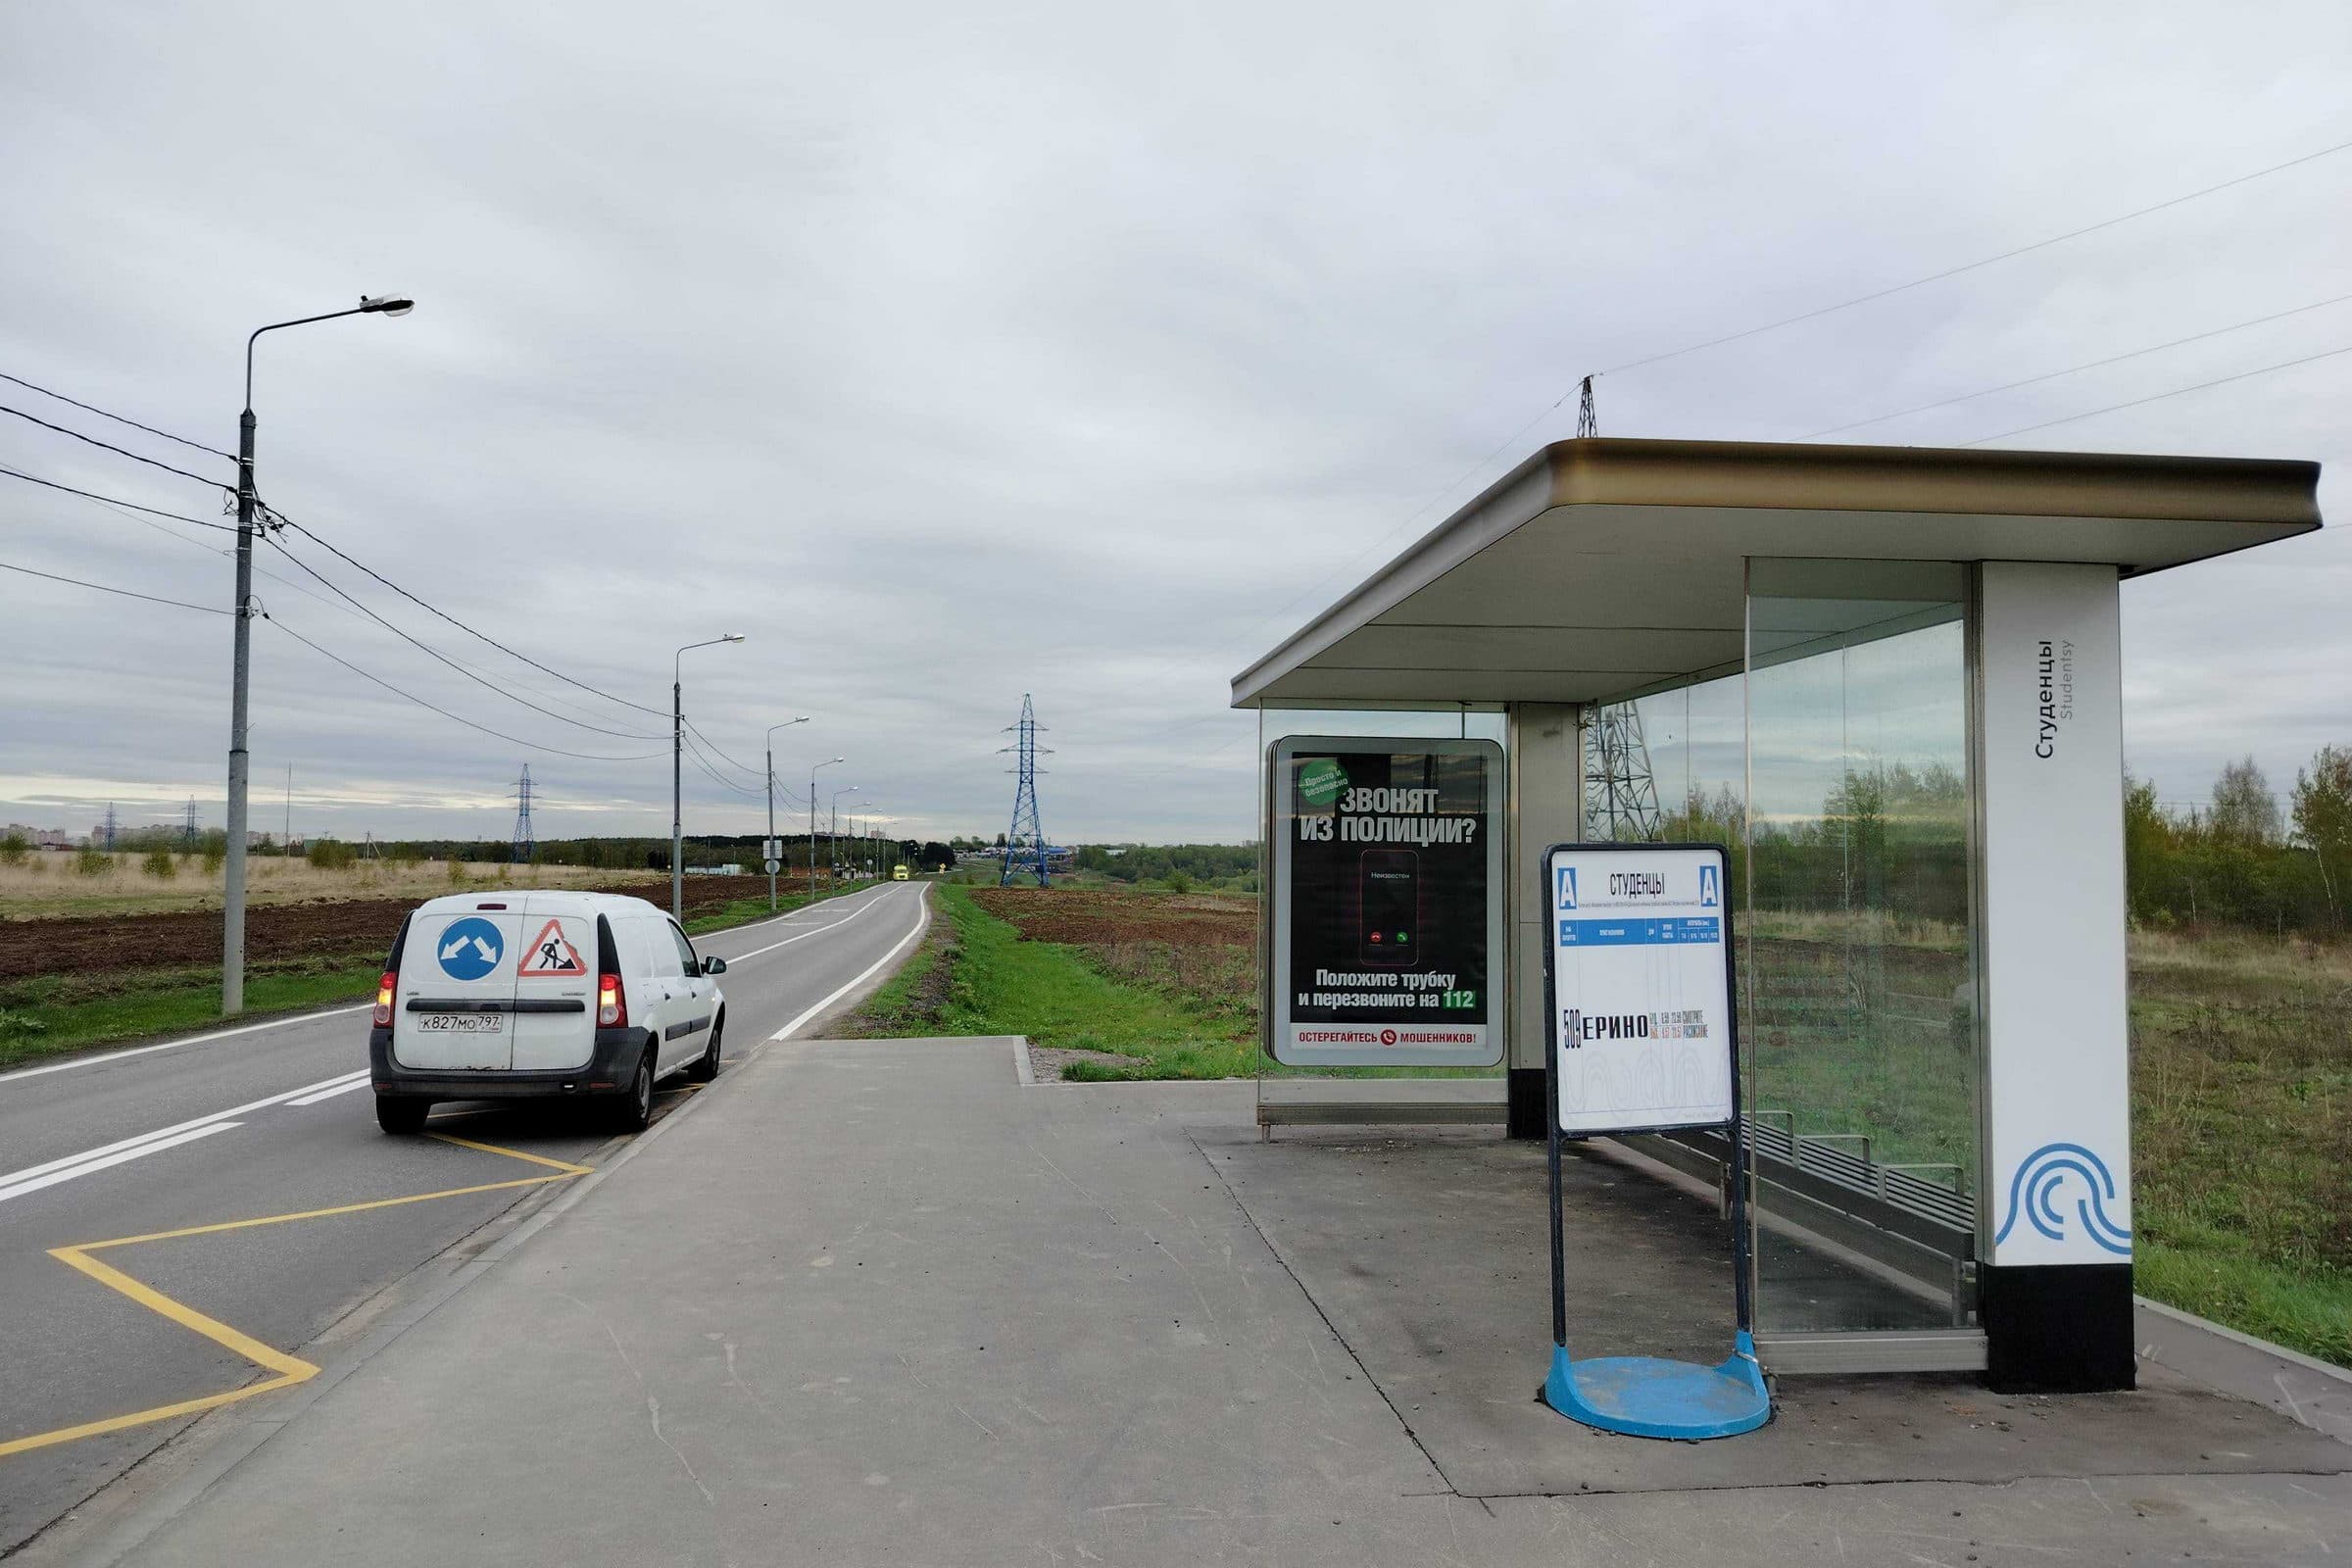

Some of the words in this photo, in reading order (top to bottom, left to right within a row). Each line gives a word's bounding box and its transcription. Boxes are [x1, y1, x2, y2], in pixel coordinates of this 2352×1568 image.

[2060, 640, 2075, 720] Studentsy
[2035, 641, 2057, 759] Студенцы
[1340, 787, 1439, 813] ЗВОНЯТ
[1300, 816, 1334, 841] ИЗ
[1341, 816, 1477, 848] ПОЛИЦИИ?
[1610, 872, 1665, 898] СТУДЕНЦЫ
[1316, 969, 1397, 987] Положите
[1401, 971, 1455, 990] трубку
[1298, 993, 1309, 1005] и
[1313, 992, 1415, 1009] перезвоните
[1420, 993, 1439, 1007] на
[1444, 991, 1474, 1007] 112
[1299, 1031, 1377, 1043] ОСТЕРЕГАЙТЕСЬ
[1400, 1033, 1476, 1044] МОШЕННИКОВ!
[1563, 1008, 1582, 1050] 509
[1583, 1014, 1648, 1040] ЕРИНО
